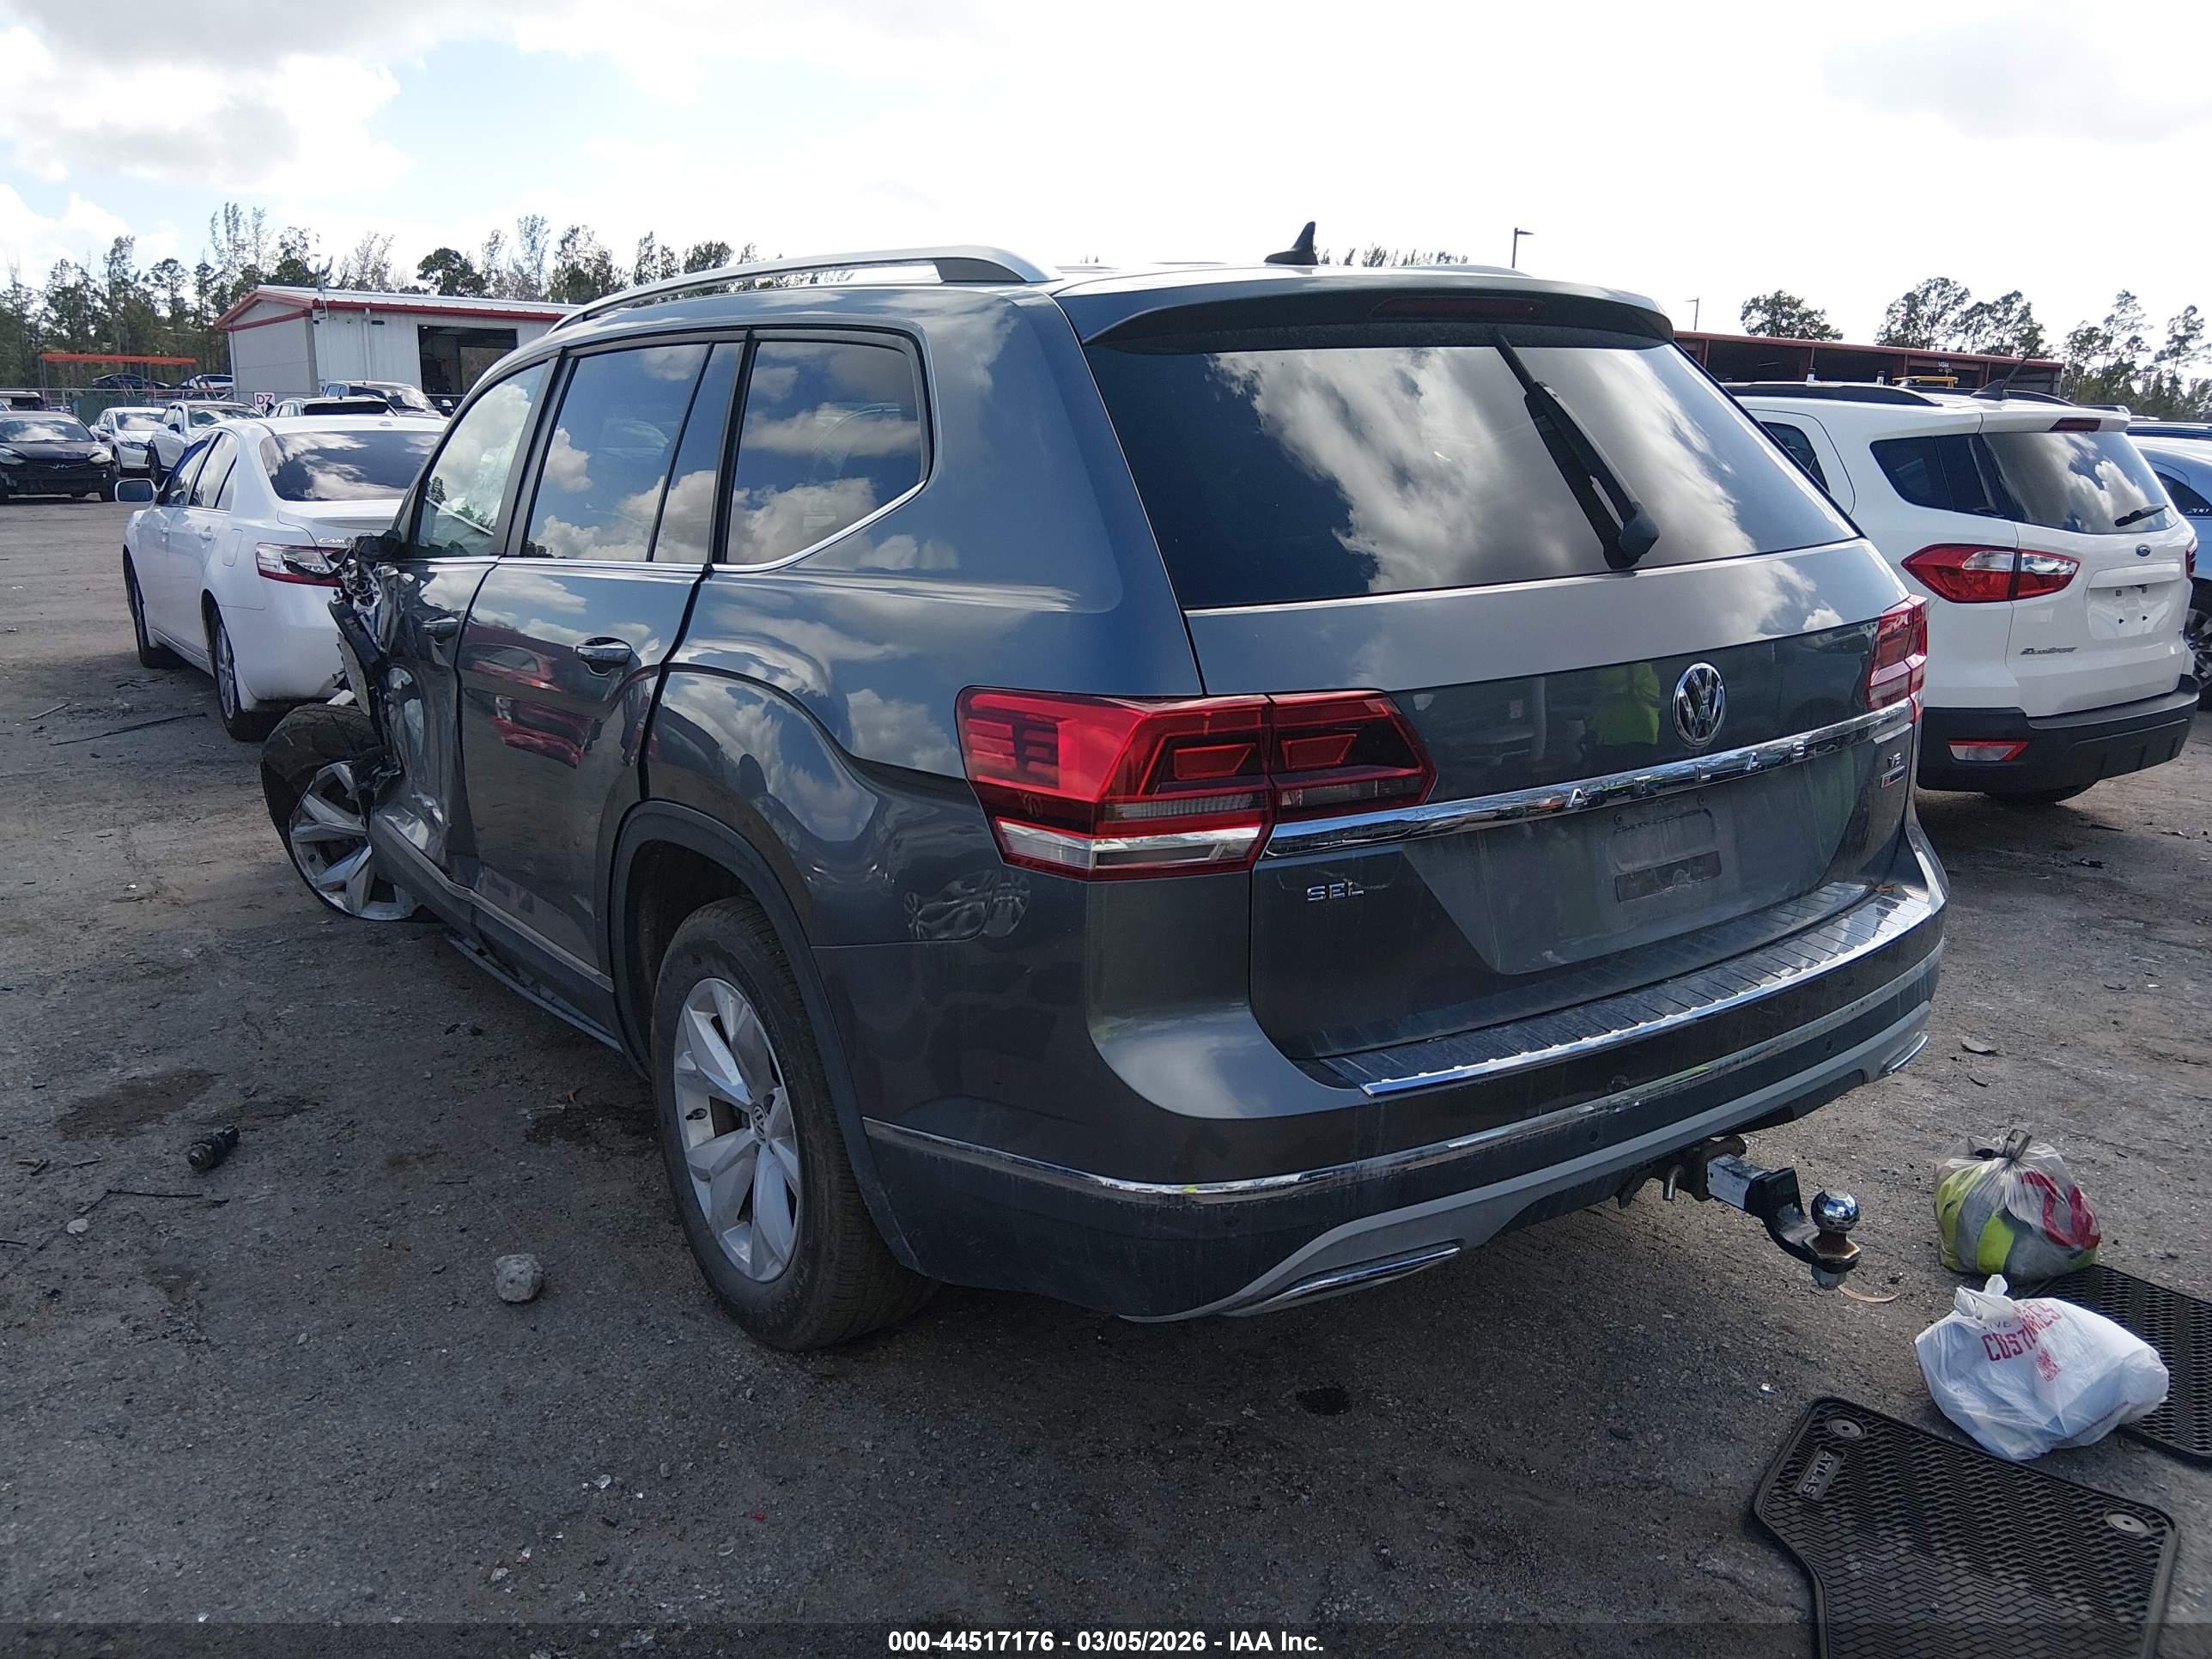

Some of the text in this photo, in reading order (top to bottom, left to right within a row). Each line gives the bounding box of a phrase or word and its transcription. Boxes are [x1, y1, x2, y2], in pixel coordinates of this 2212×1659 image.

[1565, 741, 1805, 809] ATLAS
[1307, 880, 1364, 902] SEL
[1803, 1450, 1835, 1494] ATLAS
